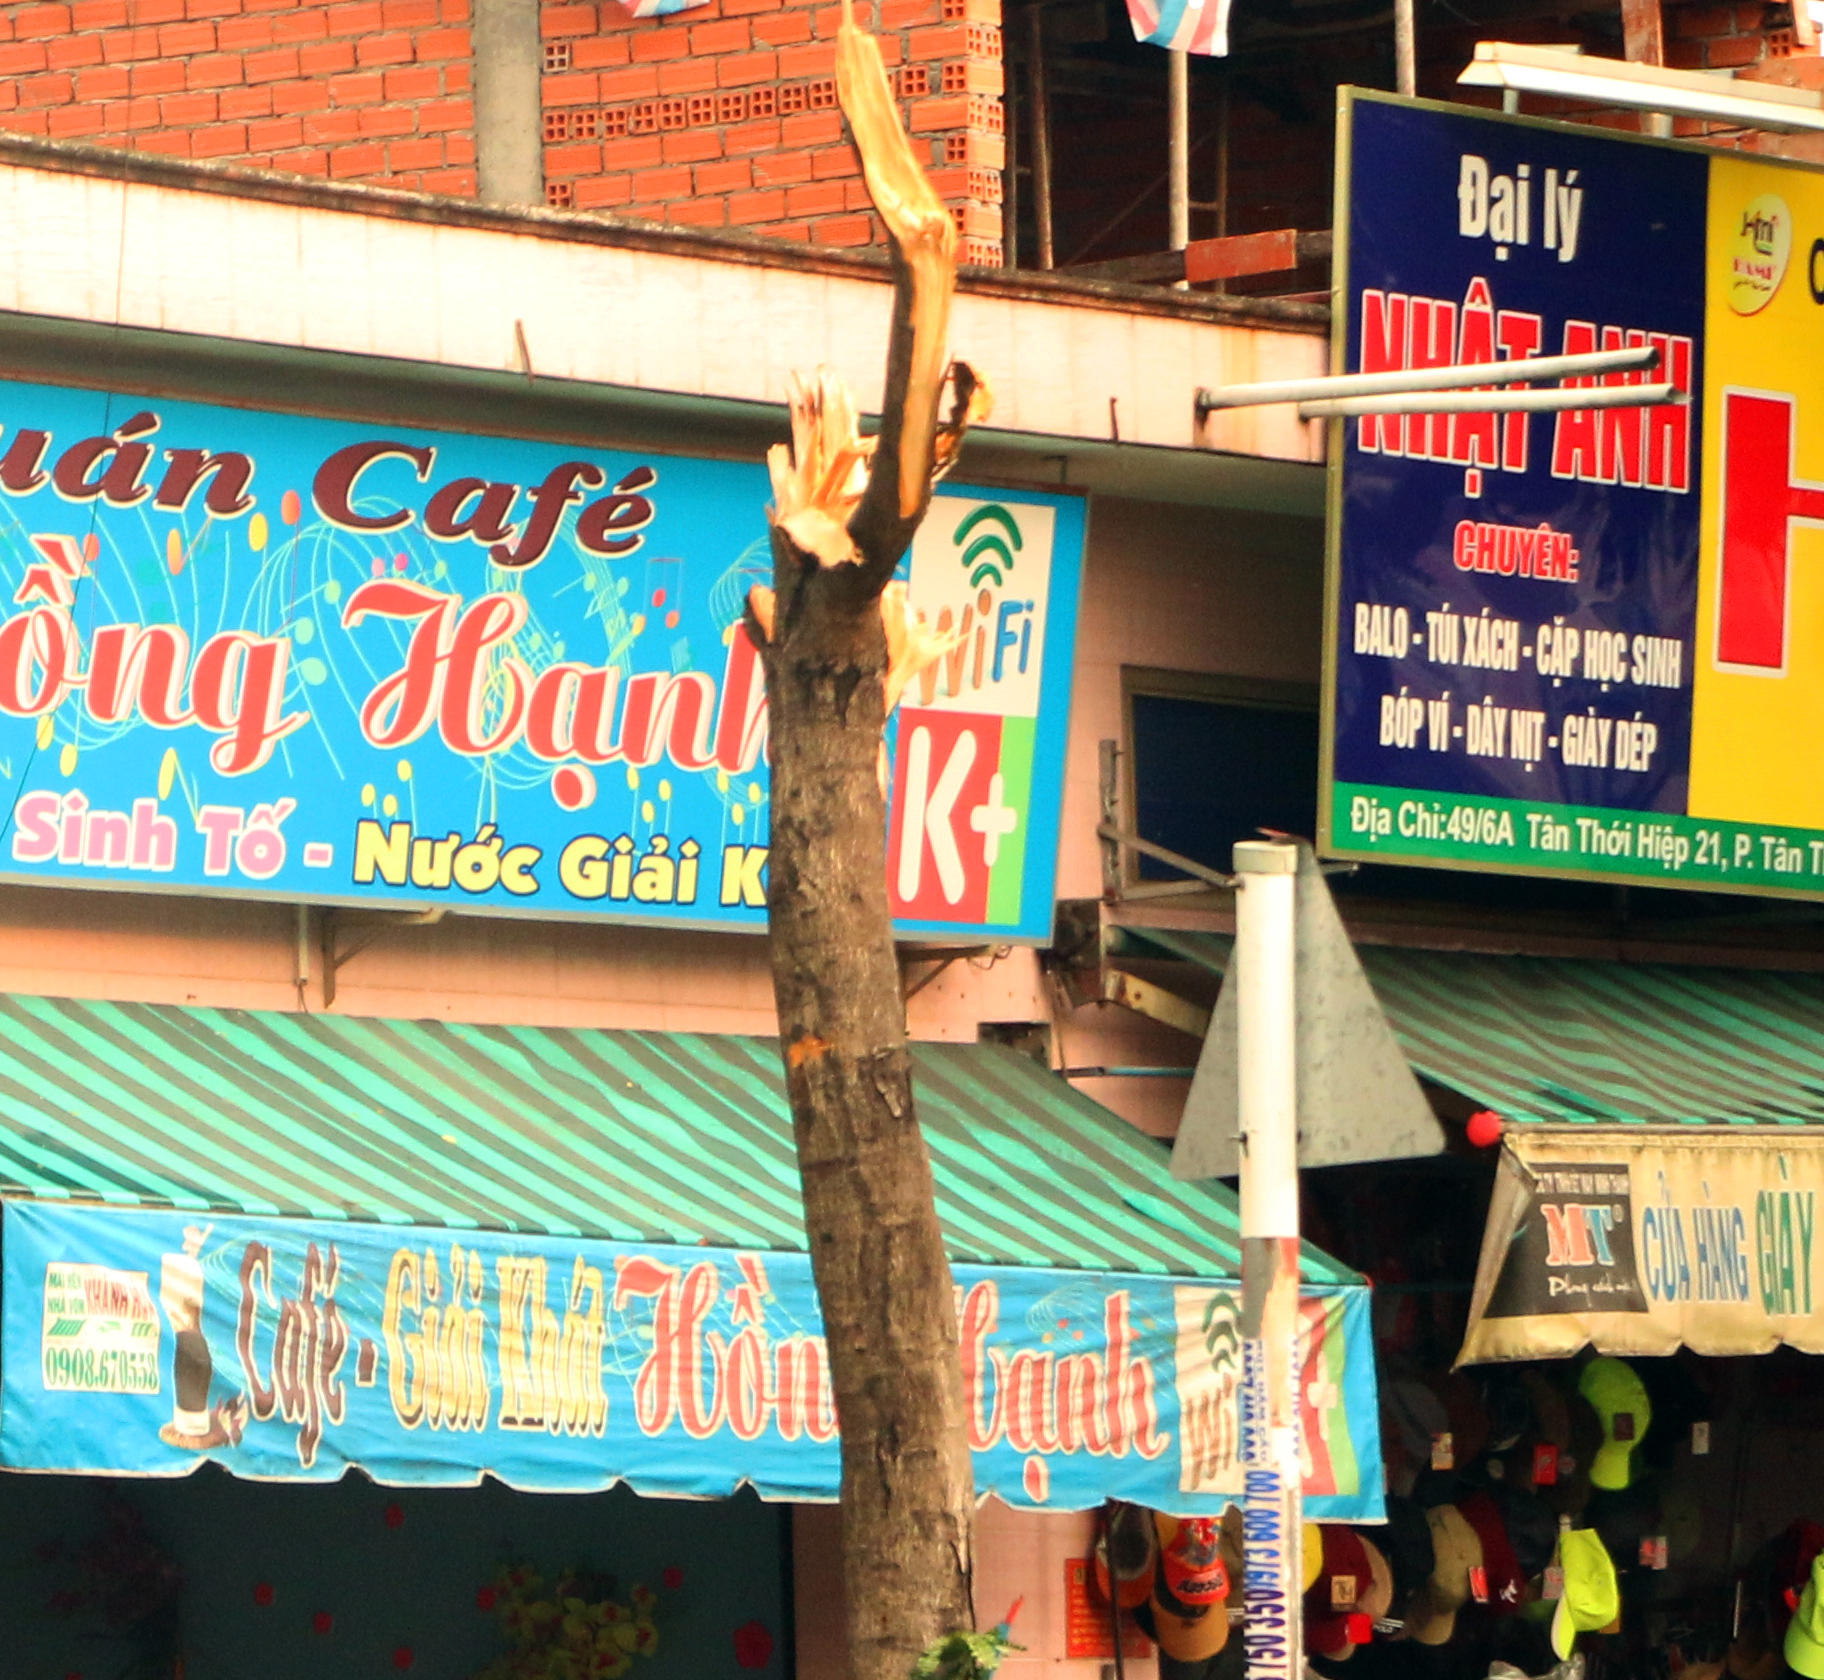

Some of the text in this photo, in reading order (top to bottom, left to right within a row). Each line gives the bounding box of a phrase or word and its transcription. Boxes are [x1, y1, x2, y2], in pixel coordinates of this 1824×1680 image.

[1457, 154, 1583, 262] Đại lý
[1358, 276, 1693, 498] NHẬT ANH
[312, 440, 659, 570] Café
[1453, 520, 1580, 584] CHUYÊN:
[1354, 602, 1409, 659] BALO
[1426, 602, 1459, 665] TÚI
[1463, 606, 1519, 671] XÁCH
[1536, 615, 1579, 688] CẶP
[1583, 628, 1626, 692] HỌC
[1631, 634, 1683, 689] SINH
[1379, 685, 1425, 749] BÓP
[1428, 690, 1451, 752] VÍ
[1466, 694, 1508, 758] DÂY
[1511, 709, 1546, 772] NỊT
[1562, 706, 1612, 768] GIÀY
[1615, 711, 1658, 772] DÉP
[11, 787, 178, 873] Sinh
[195, 796, 297, 880] Tố
[352, 819, 543, 896] Nước
[558, 833, 702, 905] Giải
[897, 725, 1018, 906] K+
[1350, 795, 1393, 843] Địa
[1526, 812, 1570, 853] Tân
[1576, 815, 1632, 858] Thới
[1637, 823, 1690, 871] Hiệp
[1694, 828, 1727, 873] 21,
[1734, 832, 1754, 870] P.
[1760, 834, 1804, 874] Tân
[1642, 1169, 1690, 1302] CỬA
[1691, 1180, 1750, 1302] HÀNG
[235, 1239, 351, 1468] Café
[382, 1243, 490, 1433] Giải
[496, 1251, 610, 1438] Khát
[612, 1251, 841, 1443] Hồn
